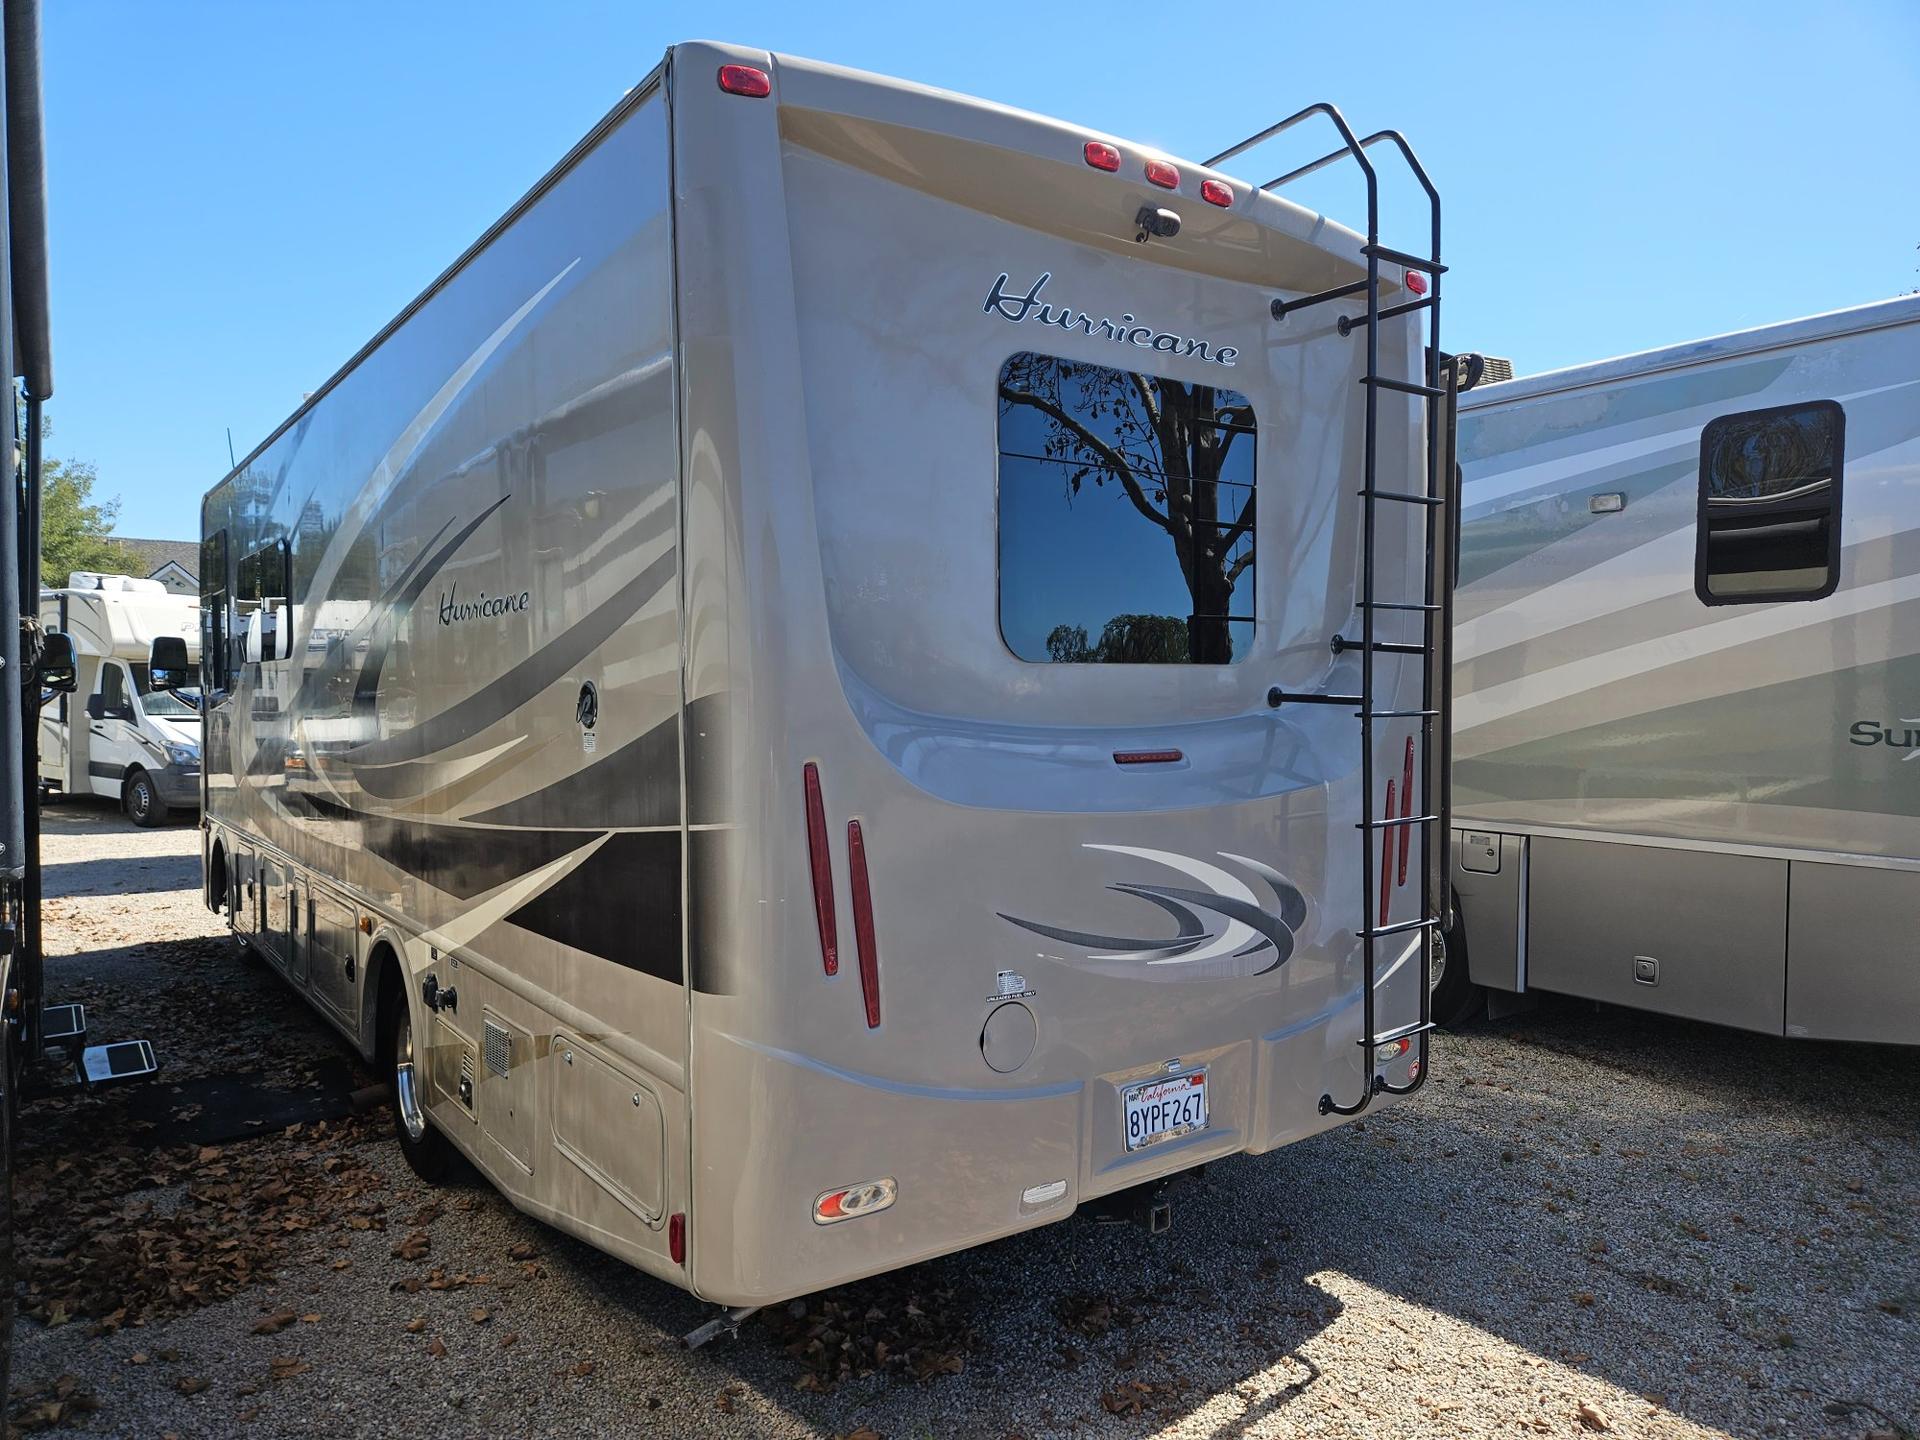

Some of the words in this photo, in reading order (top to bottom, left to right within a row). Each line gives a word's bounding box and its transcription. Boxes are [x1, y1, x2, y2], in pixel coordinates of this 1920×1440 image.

[983, 272, 1239, 366] Hurricane
[438, 578, 530, 626] Hurricane
[1850, 720, 1920, 747] Su
[1140, 1081, 1191, 1102] California
[1130, 1093, 1201, 1138] 8YPF267
